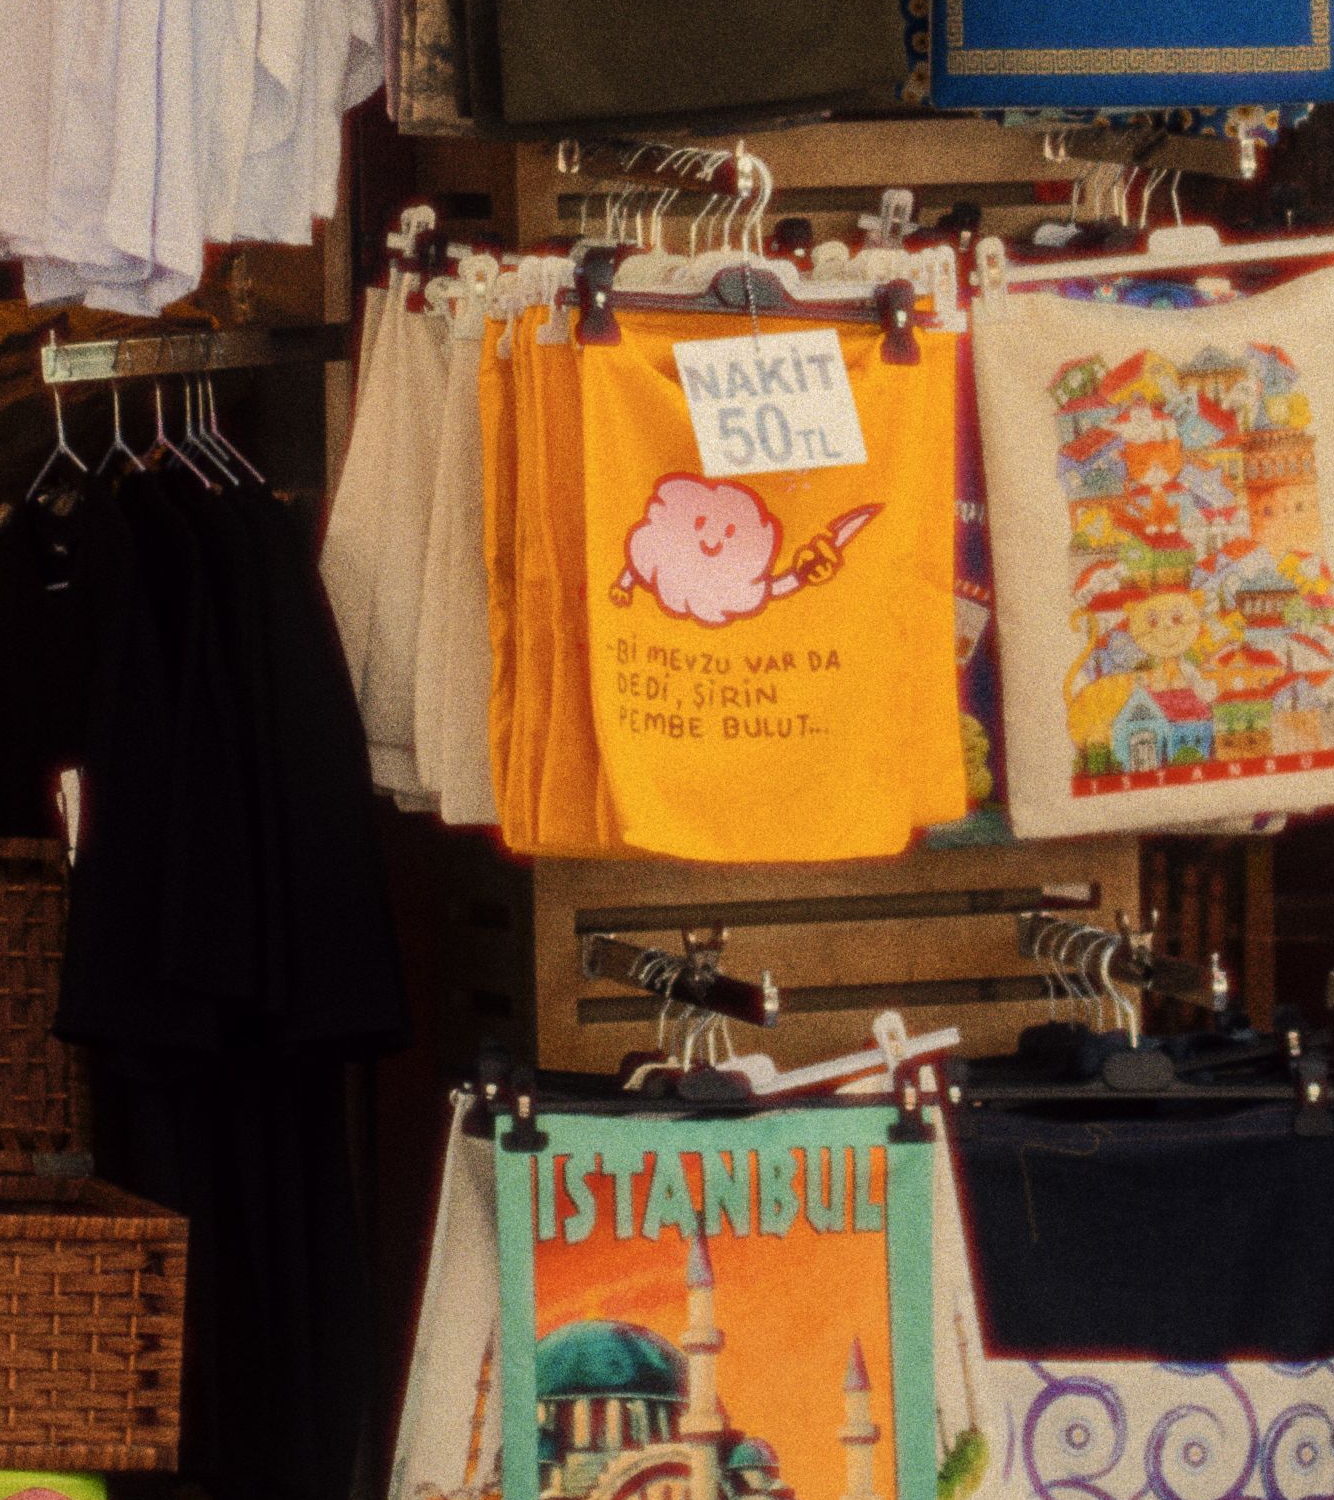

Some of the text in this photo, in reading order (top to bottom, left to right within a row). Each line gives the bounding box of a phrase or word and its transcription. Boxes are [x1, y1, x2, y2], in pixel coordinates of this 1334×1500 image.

[683, 344, 836, 403] NAKİT
[647, 645, 731, 676] MEVZU
[744, 650, 797, 674] VAR
[808, 649, 842, 673] DA
[619, 704, 704, 739] PEMBE
